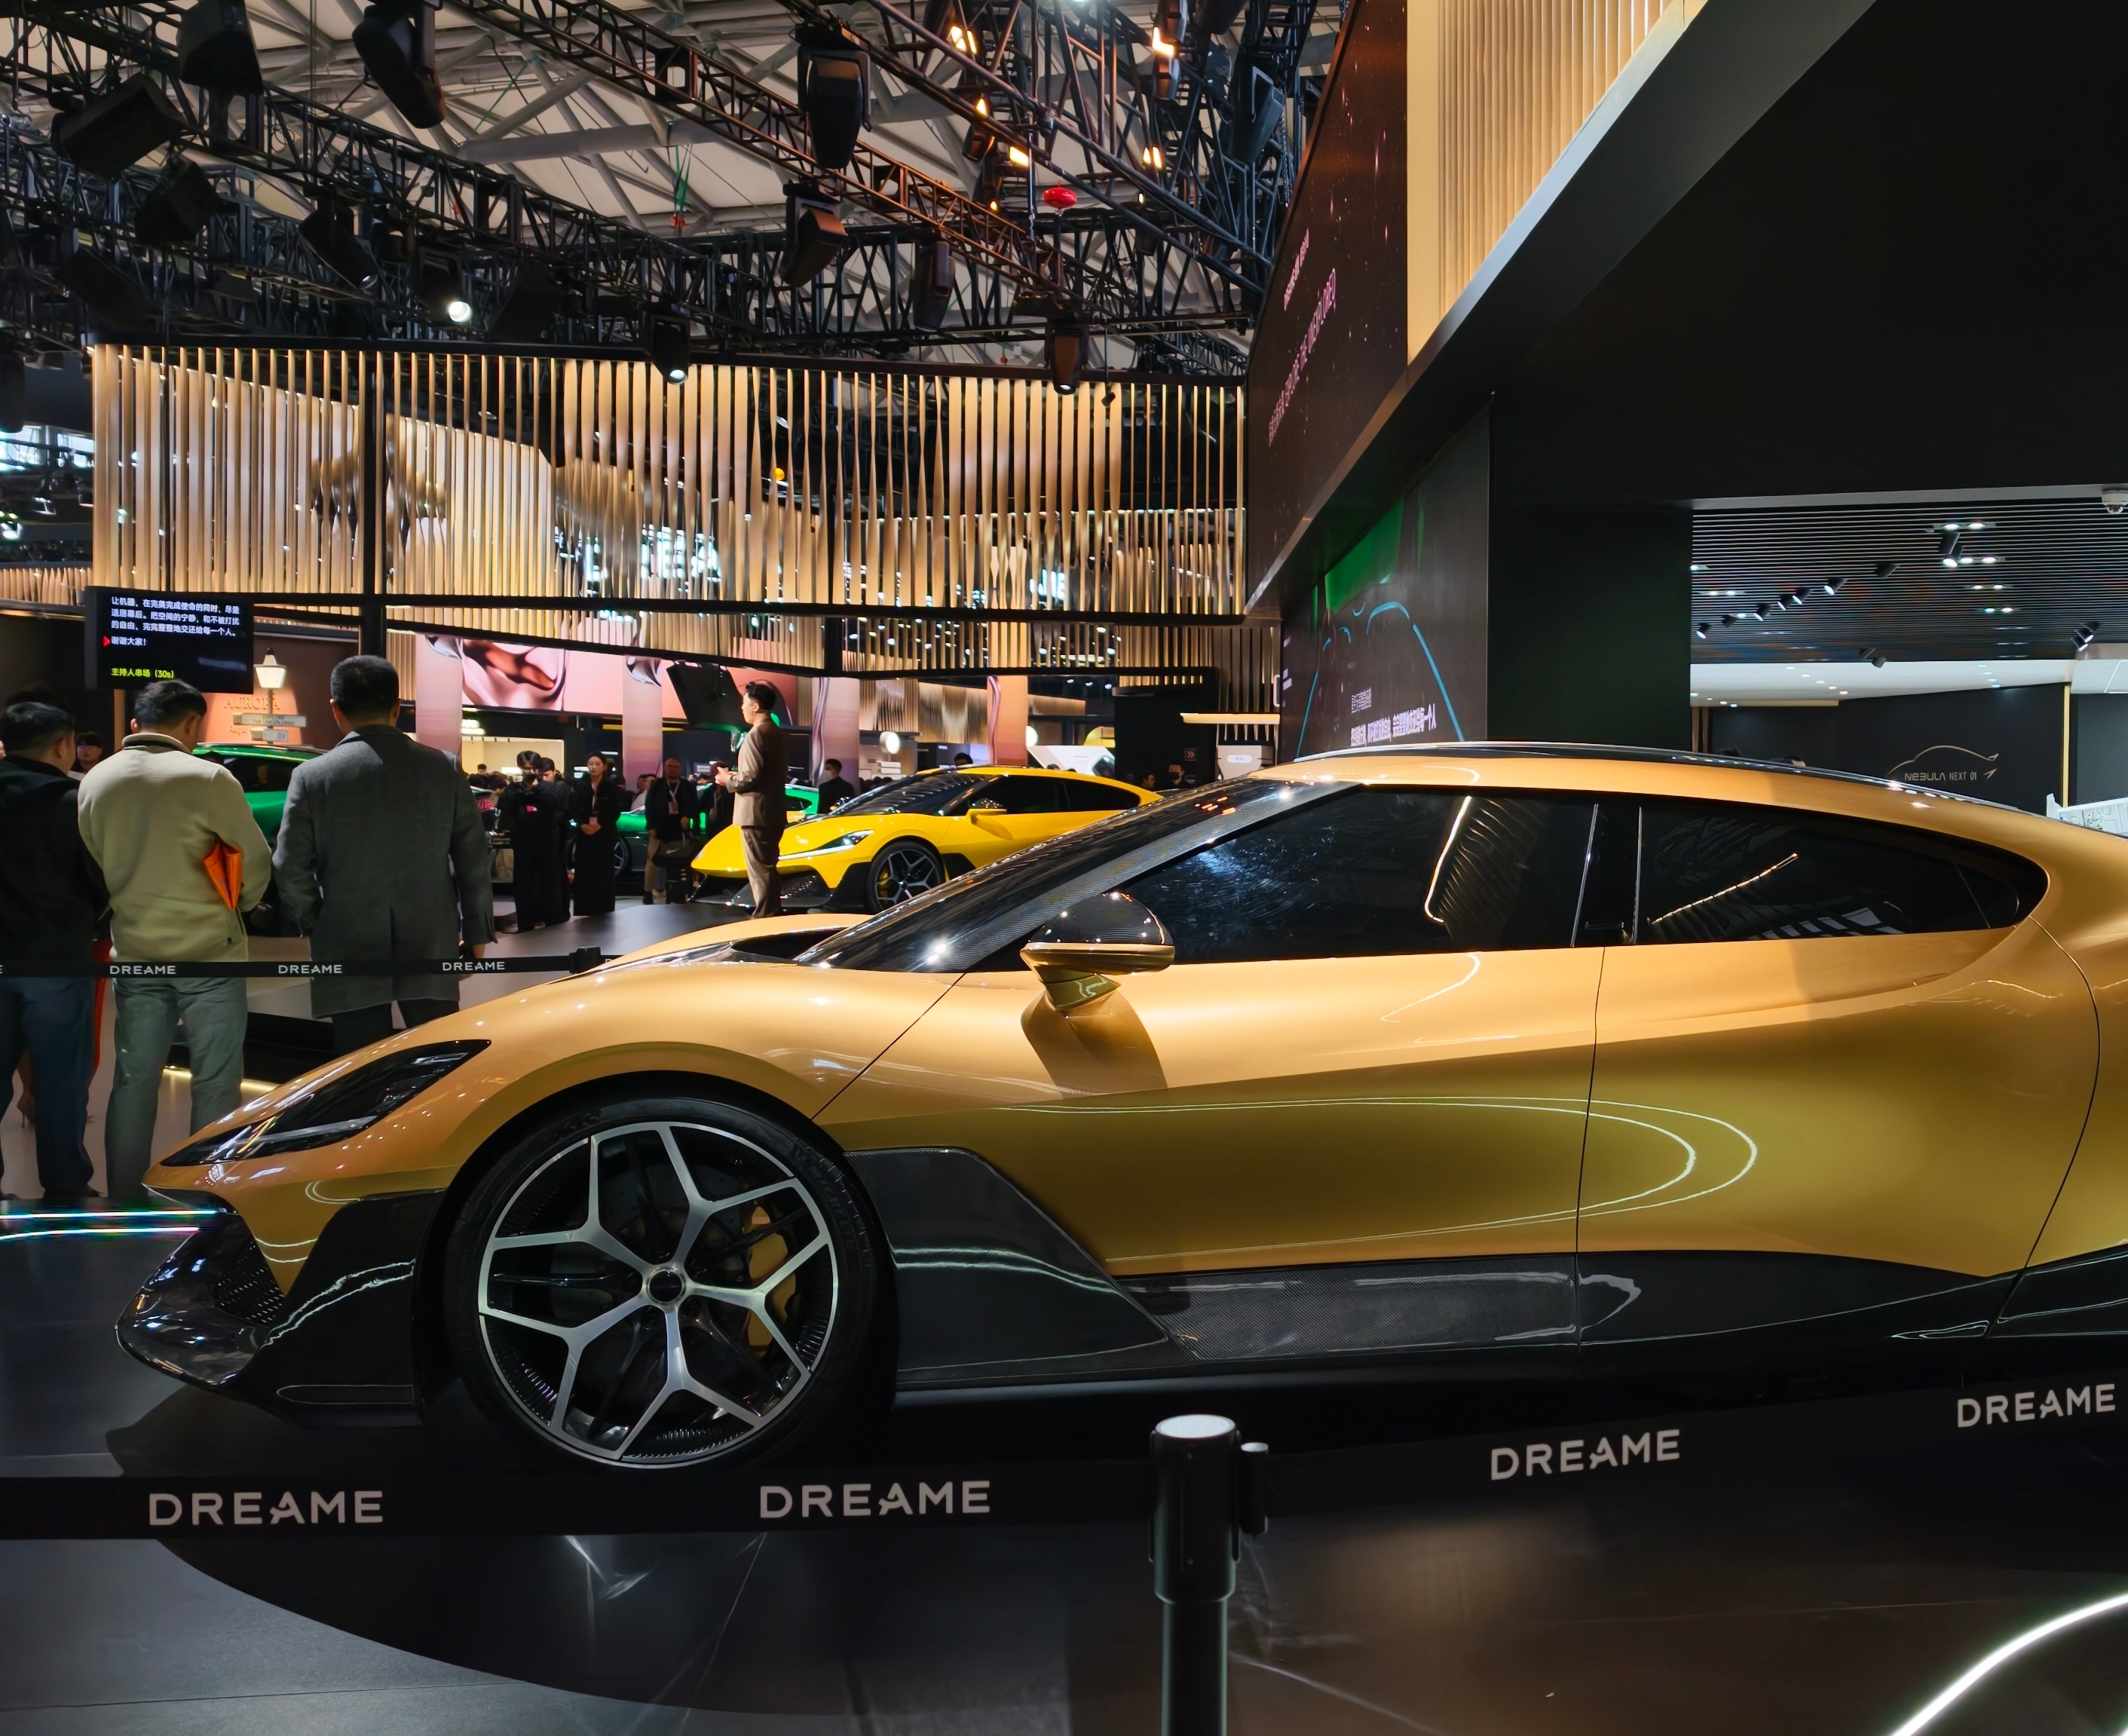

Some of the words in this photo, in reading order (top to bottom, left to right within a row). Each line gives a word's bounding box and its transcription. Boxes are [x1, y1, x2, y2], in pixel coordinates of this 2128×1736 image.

[1904, 772, 1946, 781] NEBULA
[1949, 771, 1967, 781] NEXT
[1970, 771, 1977, 781] 01
[109, 965, 176, 975] DREAME
[278, 964, 342, 974] DREAME
[442, 962, 505, 972] DREAME
[1957, 1383, 2116, 1428] DREAME
[1491, 1429, 1679, 1480] DREAME
[149, 1491, 383, 1526] DREAME
[760, 1480, 990, 1518] DREAME
